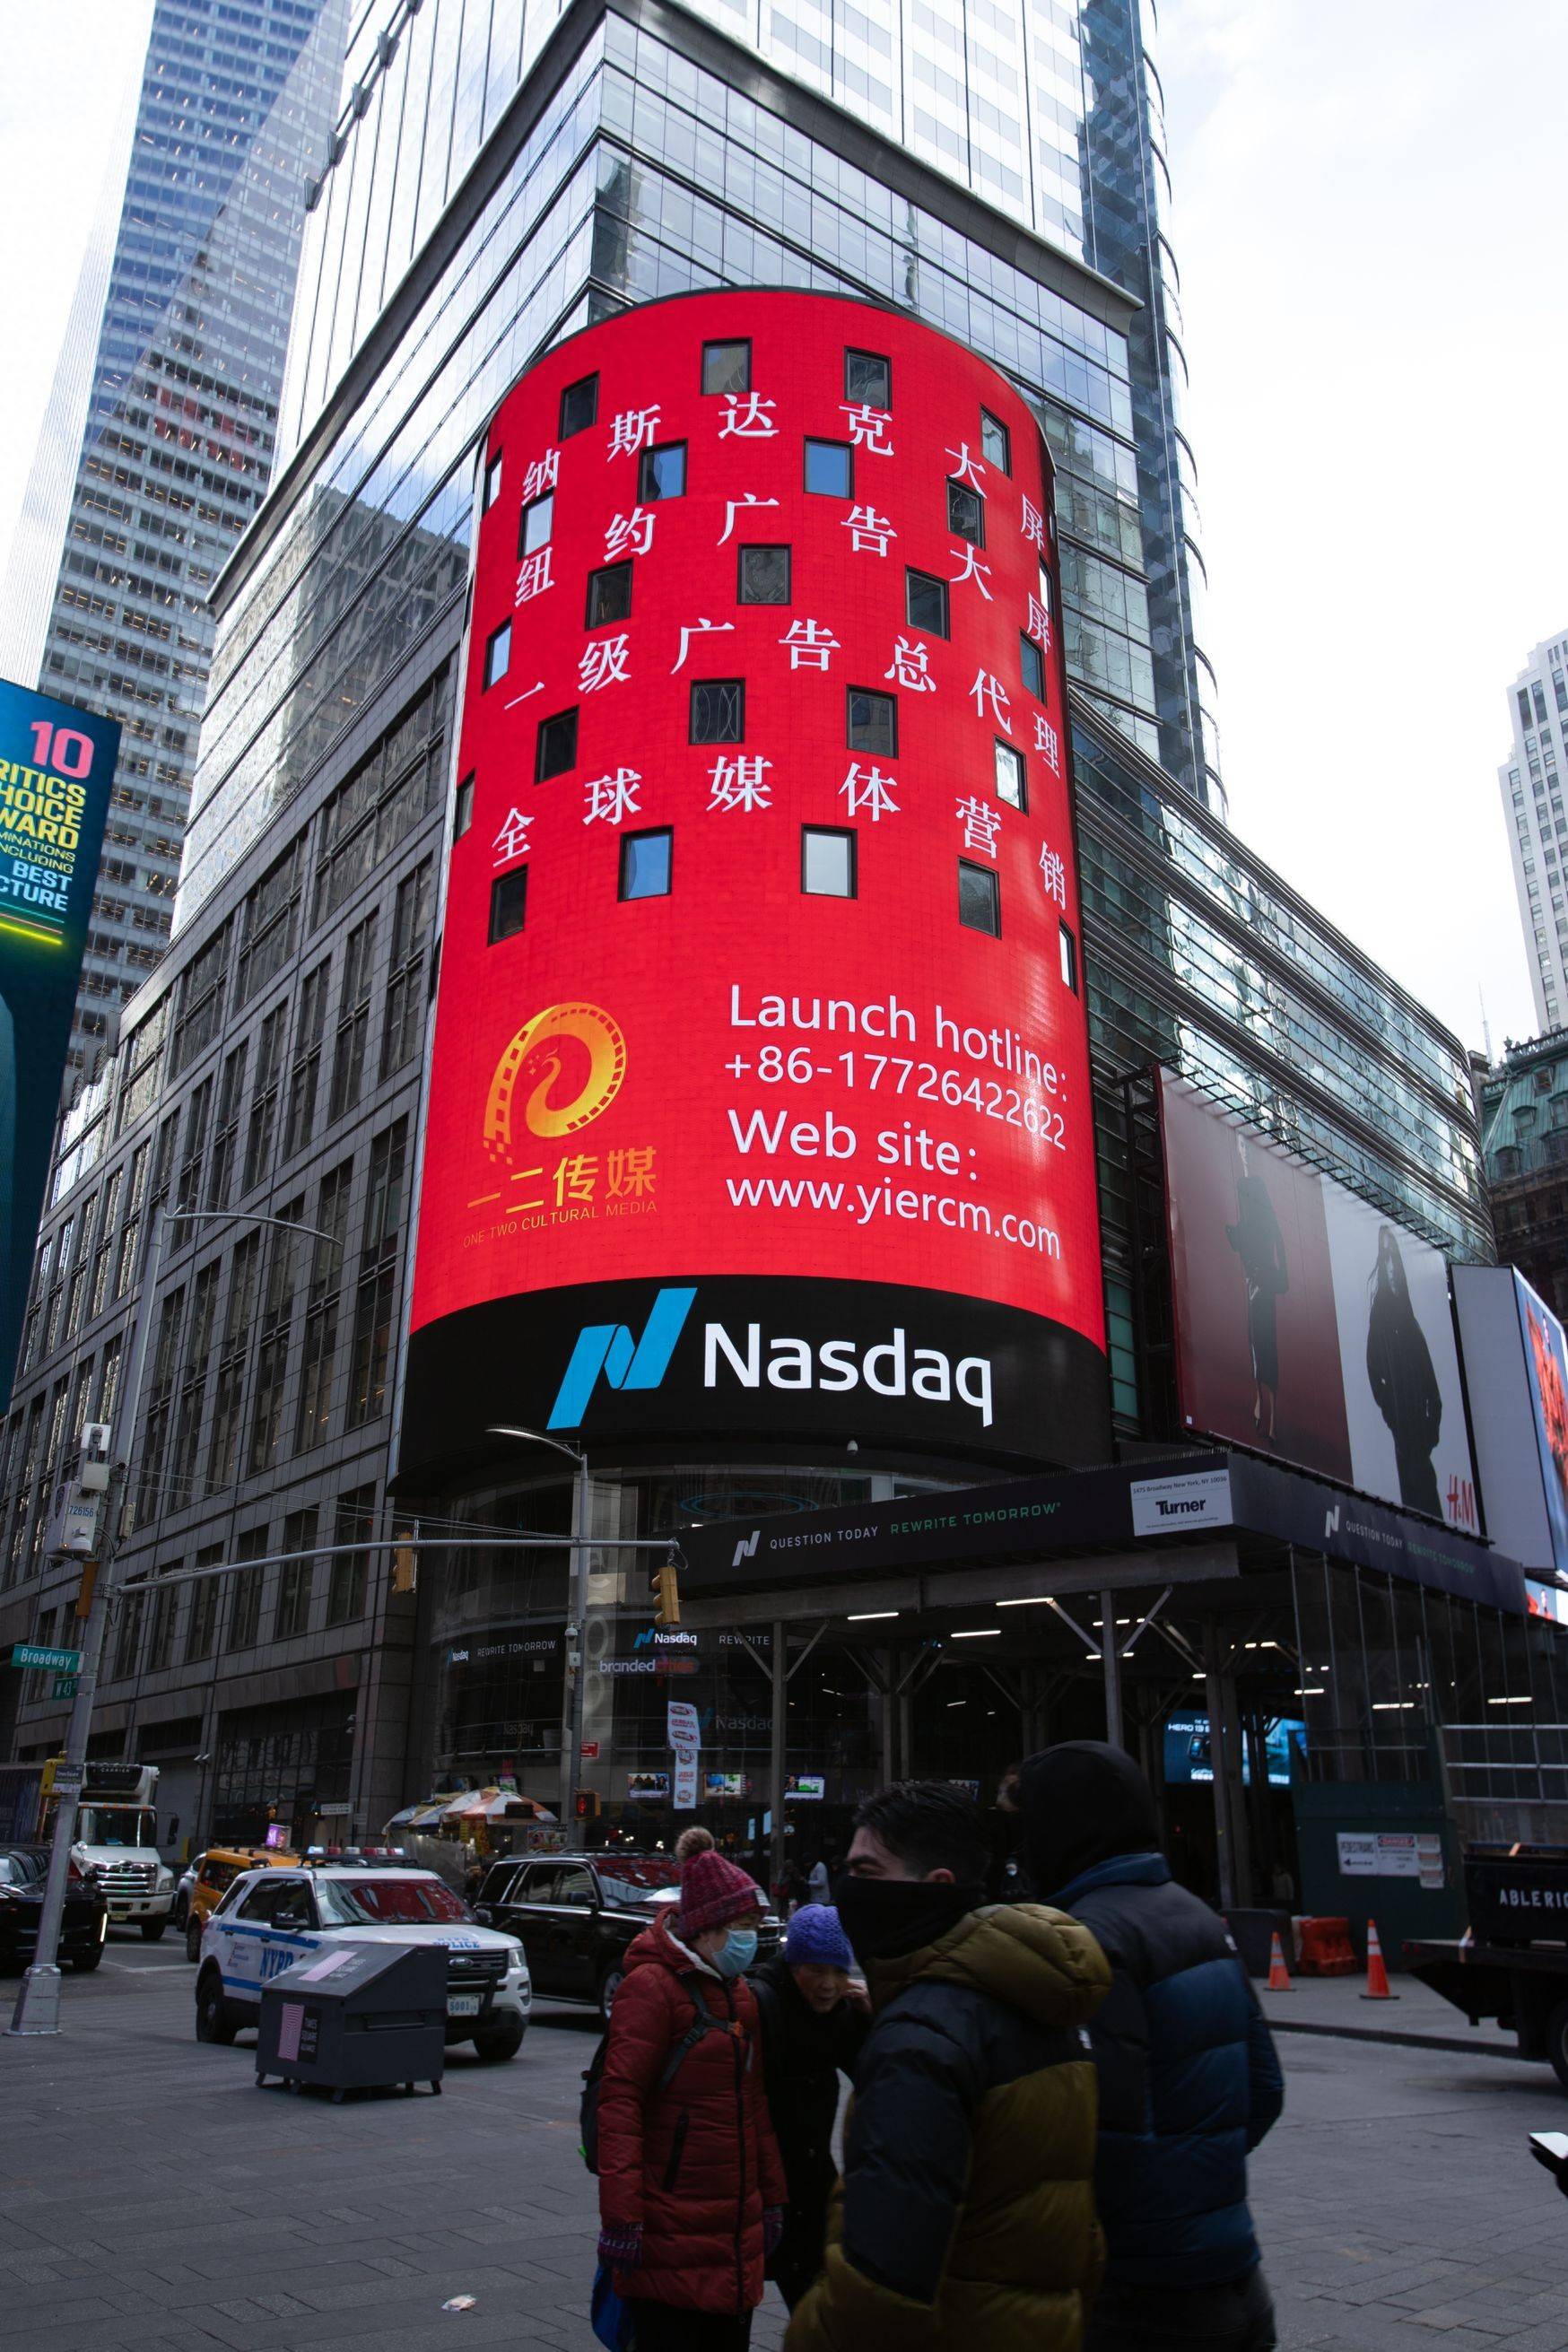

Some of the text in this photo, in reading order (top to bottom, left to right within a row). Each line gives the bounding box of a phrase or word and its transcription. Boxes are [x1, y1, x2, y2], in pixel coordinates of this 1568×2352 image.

[522, 392, 1044, 550] 纳斯达克大屏
[515, 493, 1050, 655] 纽约广告大屏
[504, 618, 1059, 779] 一级广告总代理
[30, 720, 94, 779] 10
[492, 754, 1067, 910] 全球媒体营销
[13, 860, 72, 892] BEST
[731, 984, 1067, 1102] Launch hotline:
[725, 1045, 1067, 1151] +86-17726422622
[727, 1109, 977, 1180] Web site:
[466, 1146, 657, 1214] 一二传媒
[463, 1200, 658, 1249] ONE TWO CULTURAL MEDIA
[726, 1176, 1060, 1260] www.yiercm.com
[704, 1323, 993, 1428] Nasdaq
[68, 1505, 95, 1518] 726156
[1155, 1499, 1206, 1516] Turner
[1447, 1473, 1476, 1530] H&M
[770, 1532, 832, 1550] QUESTION
[837, 1526, 879, 1541] TODAY
[891, 1516, 957, 1535] REWRITE
[1346, 1520, 1381, 1541] QUESTION
[1381, 1532, 1404, 1550] TODAY
[21, 1648, 72, 1671] Broadway
[655, 1633, 697, 1646] Nasdaq
[56, 1685, 62, 1696] W
[63, 1681, 72, 1695] 43
[259, 1947, 293, 1979] NYPD
